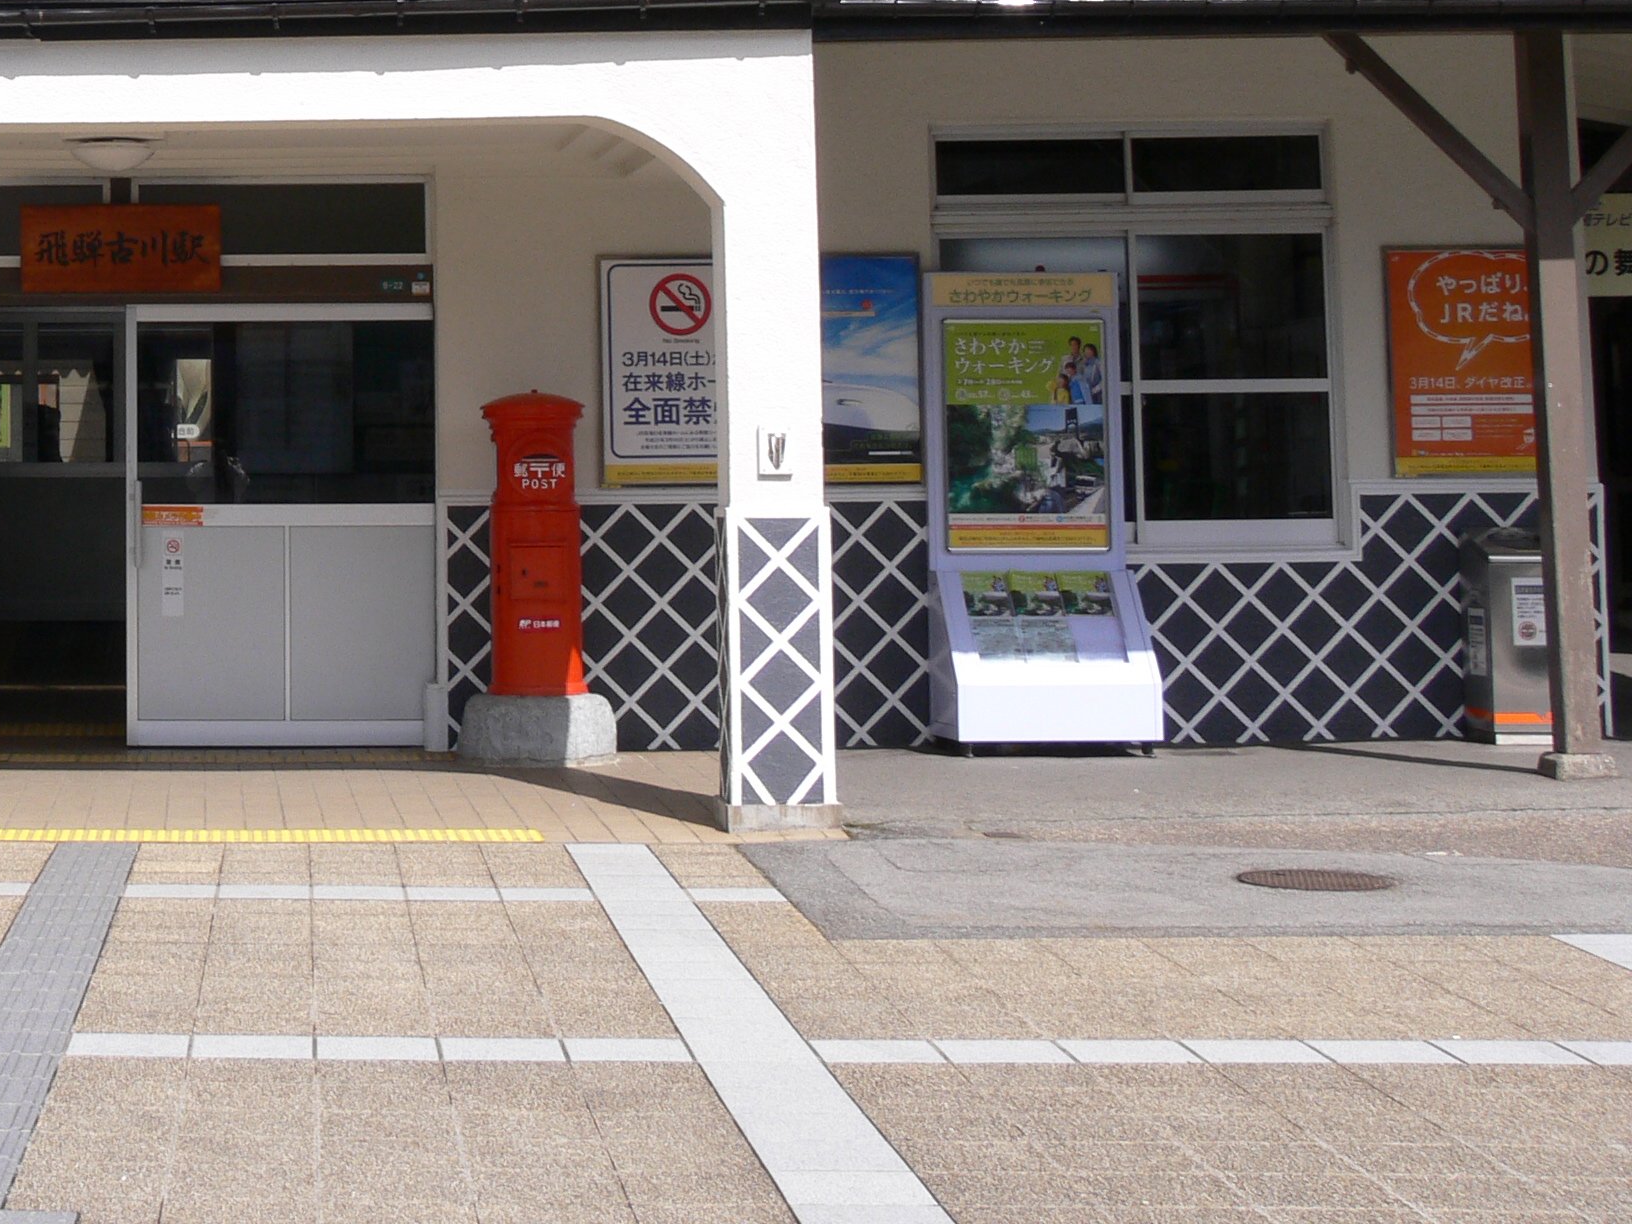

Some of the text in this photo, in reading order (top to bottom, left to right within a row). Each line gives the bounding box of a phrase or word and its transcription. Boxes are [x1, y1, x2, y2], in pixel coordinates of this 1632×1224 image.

[1583, 212, 1632, 226] テレビ
[949, 289, 1092, 304] さわやかウォーキング
[955, 338, 1026, 356] さわやか
[955, 356, 1055, 375] ウォーキング
[622, 396, 717, 426] 全面禁
[522, 478, 558, 489] POST
